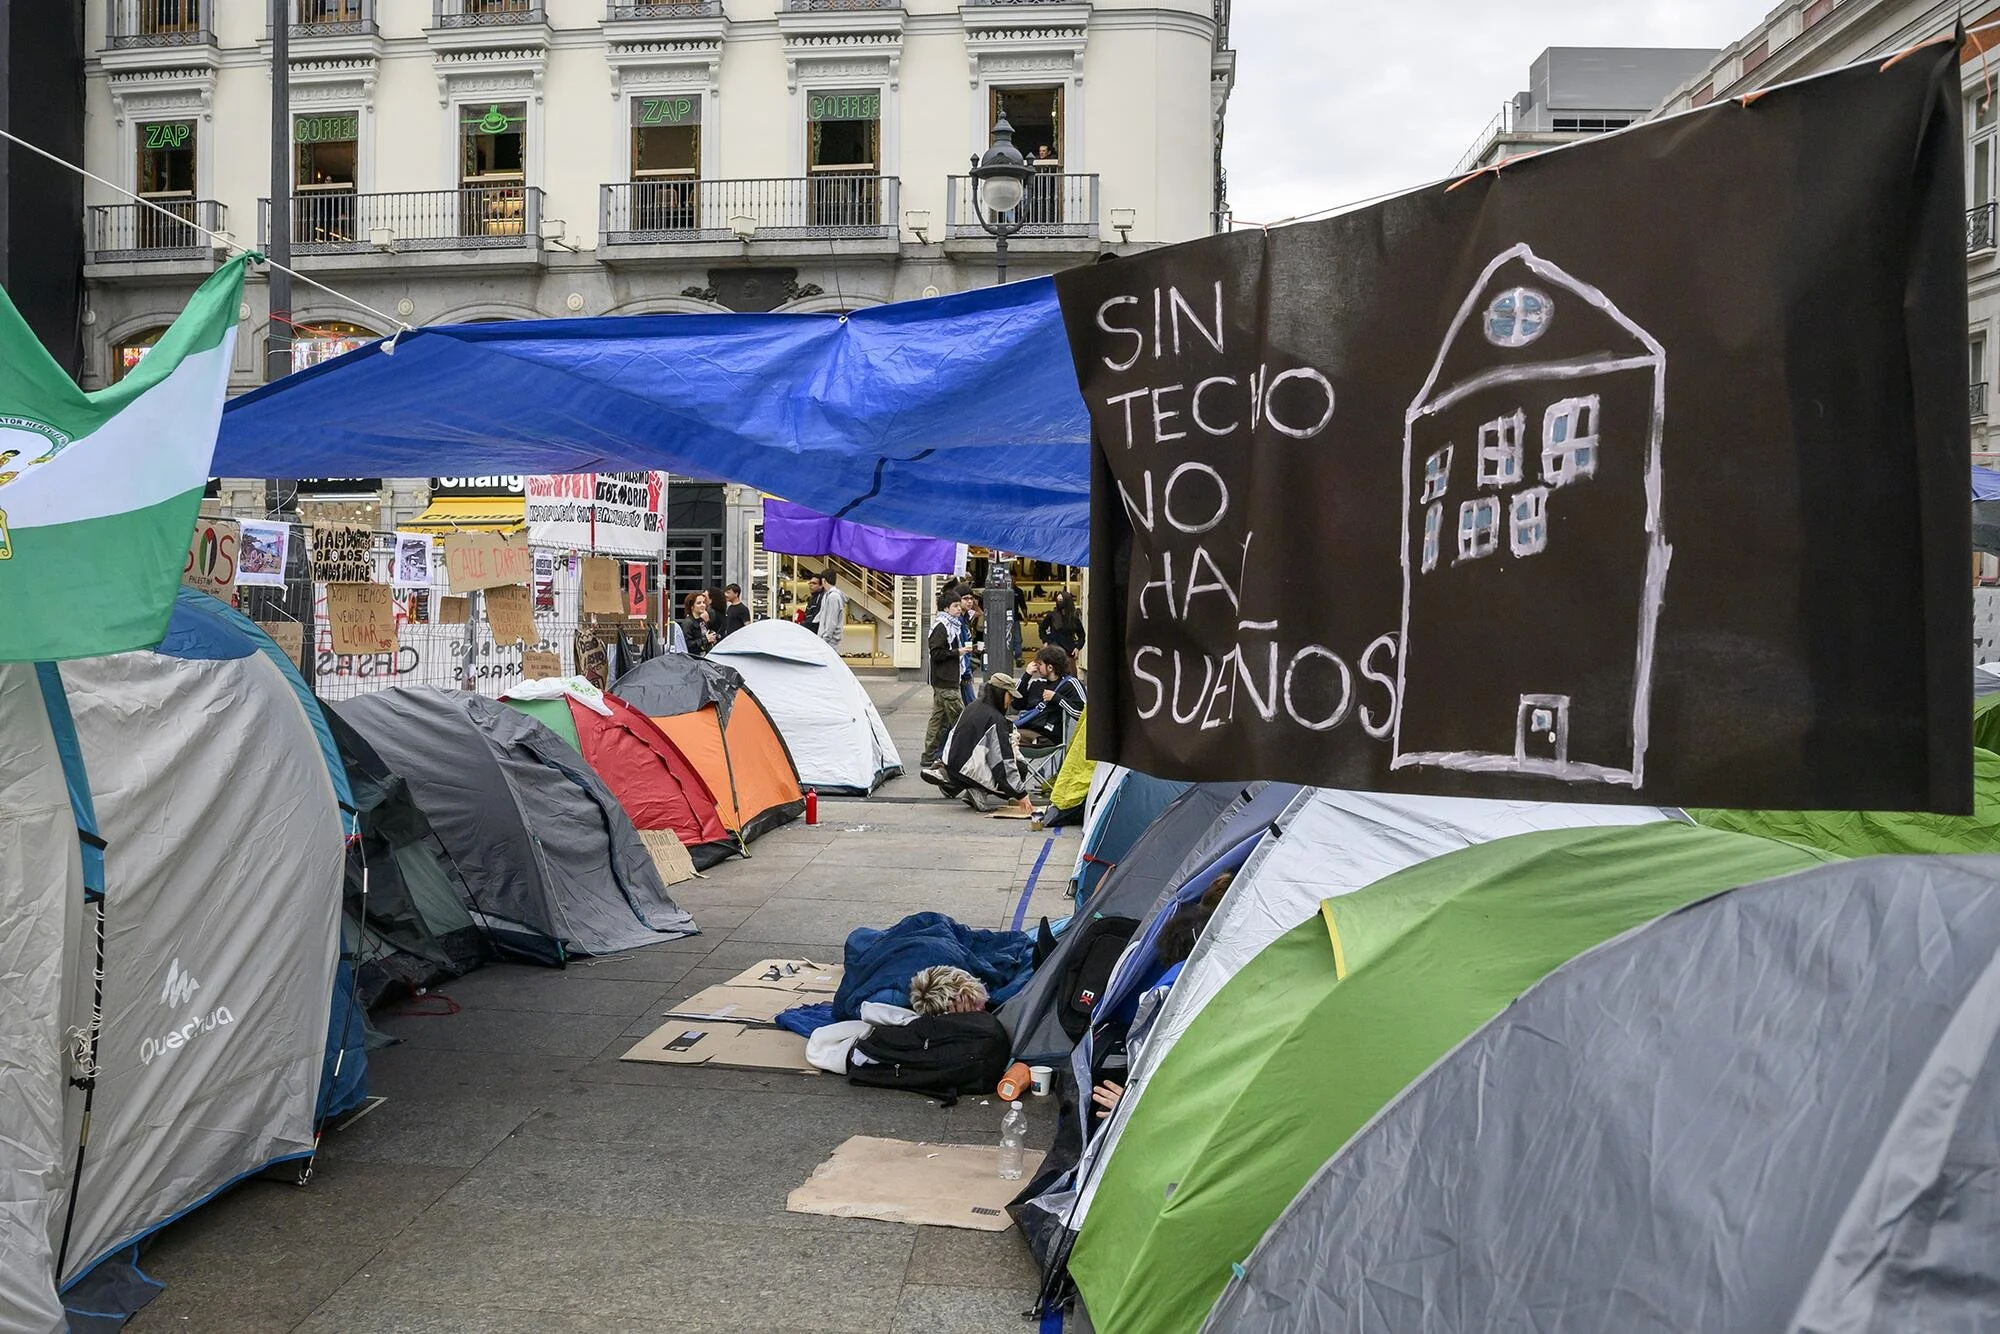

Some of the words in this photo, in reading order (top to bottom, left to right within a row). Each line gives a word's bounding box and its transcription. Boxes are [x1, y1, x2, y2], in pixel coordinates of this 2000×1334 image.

[642, 98, 692, 124] ZAP
[808, 93, 880, 121] COFFEE
[145, 124, 190, 149] ZAP
[295, 116, 359, 143] COFFEE
[1095, 280, 1224, 372] SIN
[1106, 363, 1336, 450] TECHO
[618, 485, 648, 508] MORIR
[1117, 460, 1230, 534] NO
[1133, 619, 1400, 740] SUEÑOS
[140, 1005, 235, 1066] Quechua
